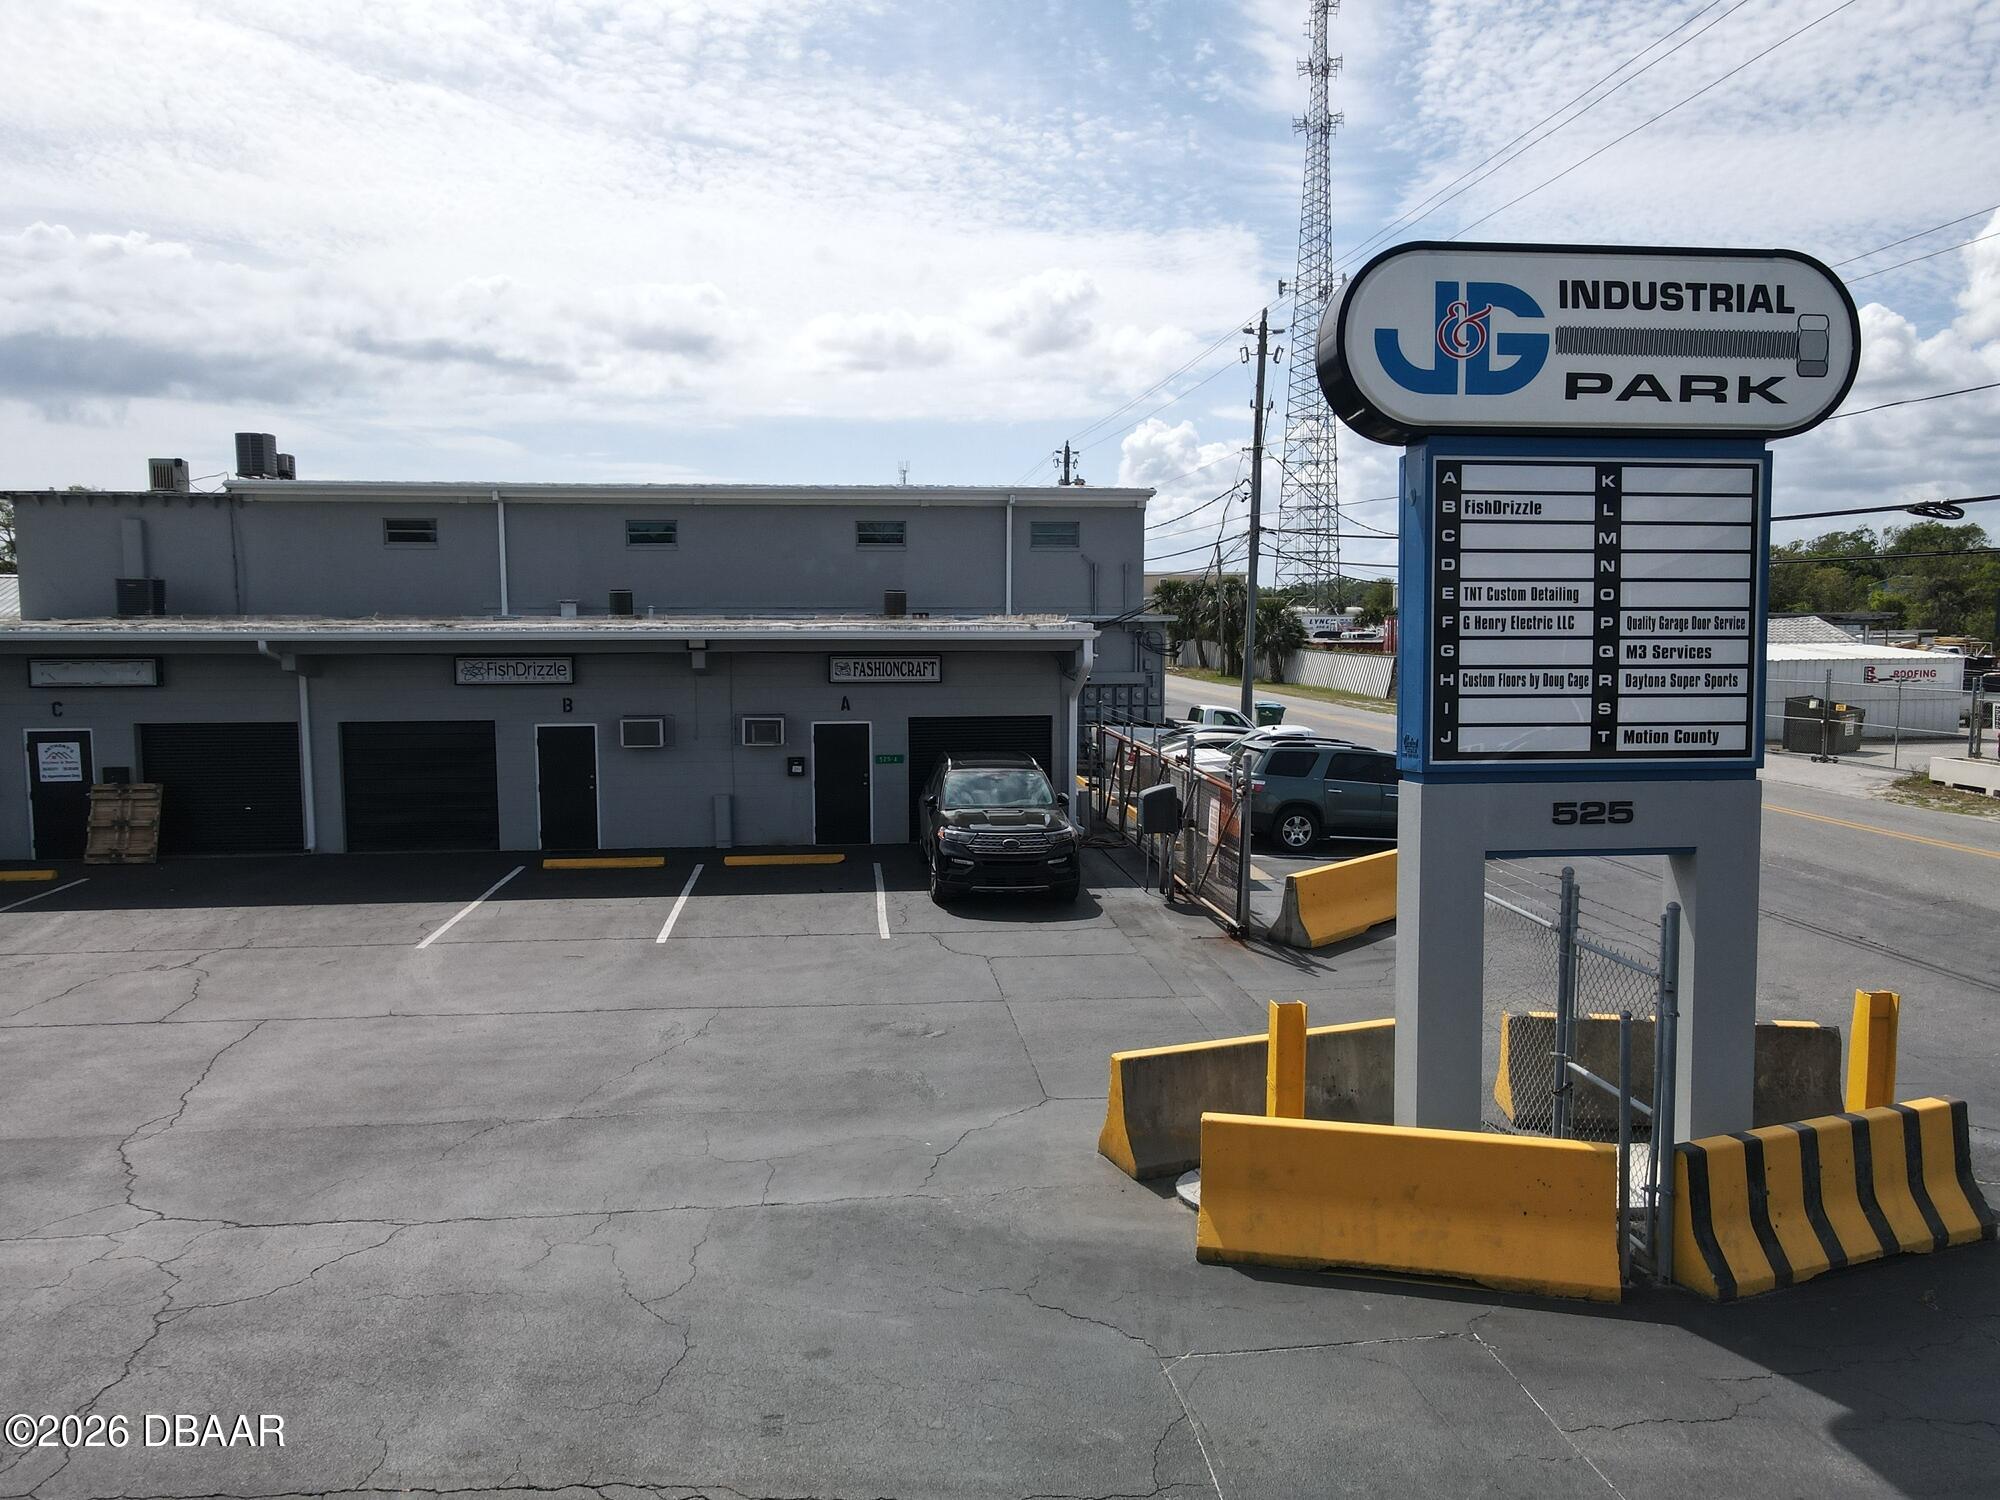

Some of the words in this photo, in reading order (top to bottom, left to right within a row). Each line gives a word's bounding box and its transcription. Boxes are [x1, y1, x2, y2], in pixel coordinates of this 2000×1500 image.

[1559, 279, 1795, 314] INDUSTRIAL
[1565, 372, 1787, 404] PARK
[1442, 472, 1457, 483] A
[1602, 476, 1615, 487] K
[1442, 501, 1456, 513] B
[1464, 500, 1542, 515] FishDrizzle
[1603, 504, 1613, 516] L
[1442, 530, 1455, 542] C
[1599, 533, 1616, 544] M
[1442, 559, 1455, 571] D
[1601, 561, 1615, 572] N
[1442, 588, 1454, 599] E
[1464, 587, 1482, 601] TNT
[1487, 587, 1526, 601] Custom
[1531, 587, 1579, 603] Detailing
[1600, 589, 1614, 601] O
[1442, 616, 1453, 628] F
[1463, 616, 1470, 629] G
[1475, 616, 1506, 632] Henry
[1511, 616, 1553, 629] Electric
[1557, 616, 1574, 629] LLC
[1601, 618, 1613, 629] P
[1627, 616, 1656, 632] Quality
[1659, 616, 1688, 632] Garage
[1692, 616, 1711, 630] Door
[1714, 616, 1745, 630] Service
[1441, 645, 1454, 657] G
[1599, 646, 1614, 658] Q
[1626, 645, 1647, 659] M3
[1652, 645, 1711, 659] Services
[487, 662, 567, 676] FishDrizzle
[853, 662, 936, 676] FASHIONCRAFT
[1893, 670, 1936, 678] ROOFING
[1440, 674, 1454, 686] H
[1462, 673, 1495, 687] Custom
[1499, 673, 1526, 687] Floors
[1530, 673, 1539, 689] by
[1543, 673, 1564, 689] Doug
[1568, 673, 1589, 689] Cage
[1599, 675, 1612, 686] R
[1625, 674, 1666, 689] Daytona
[1670, 674, 1700, 689] Super
[1704, 673, 1738, 689] Sports
[52, 701, 63, 717] C
[563, 698, 573, 713] B
[841, 696, 850, 711] A
[1444, 703, 1448, 714] I
[1598, 703, 1611, 715] S
[1440, 732, 1451, 743] J
[1599, 732, 1609, 742] T
[1624, 730, 1668, 744] Motion
[1674, 729, 1719, 745] County
[1552, 801, 1633, 824] 525
